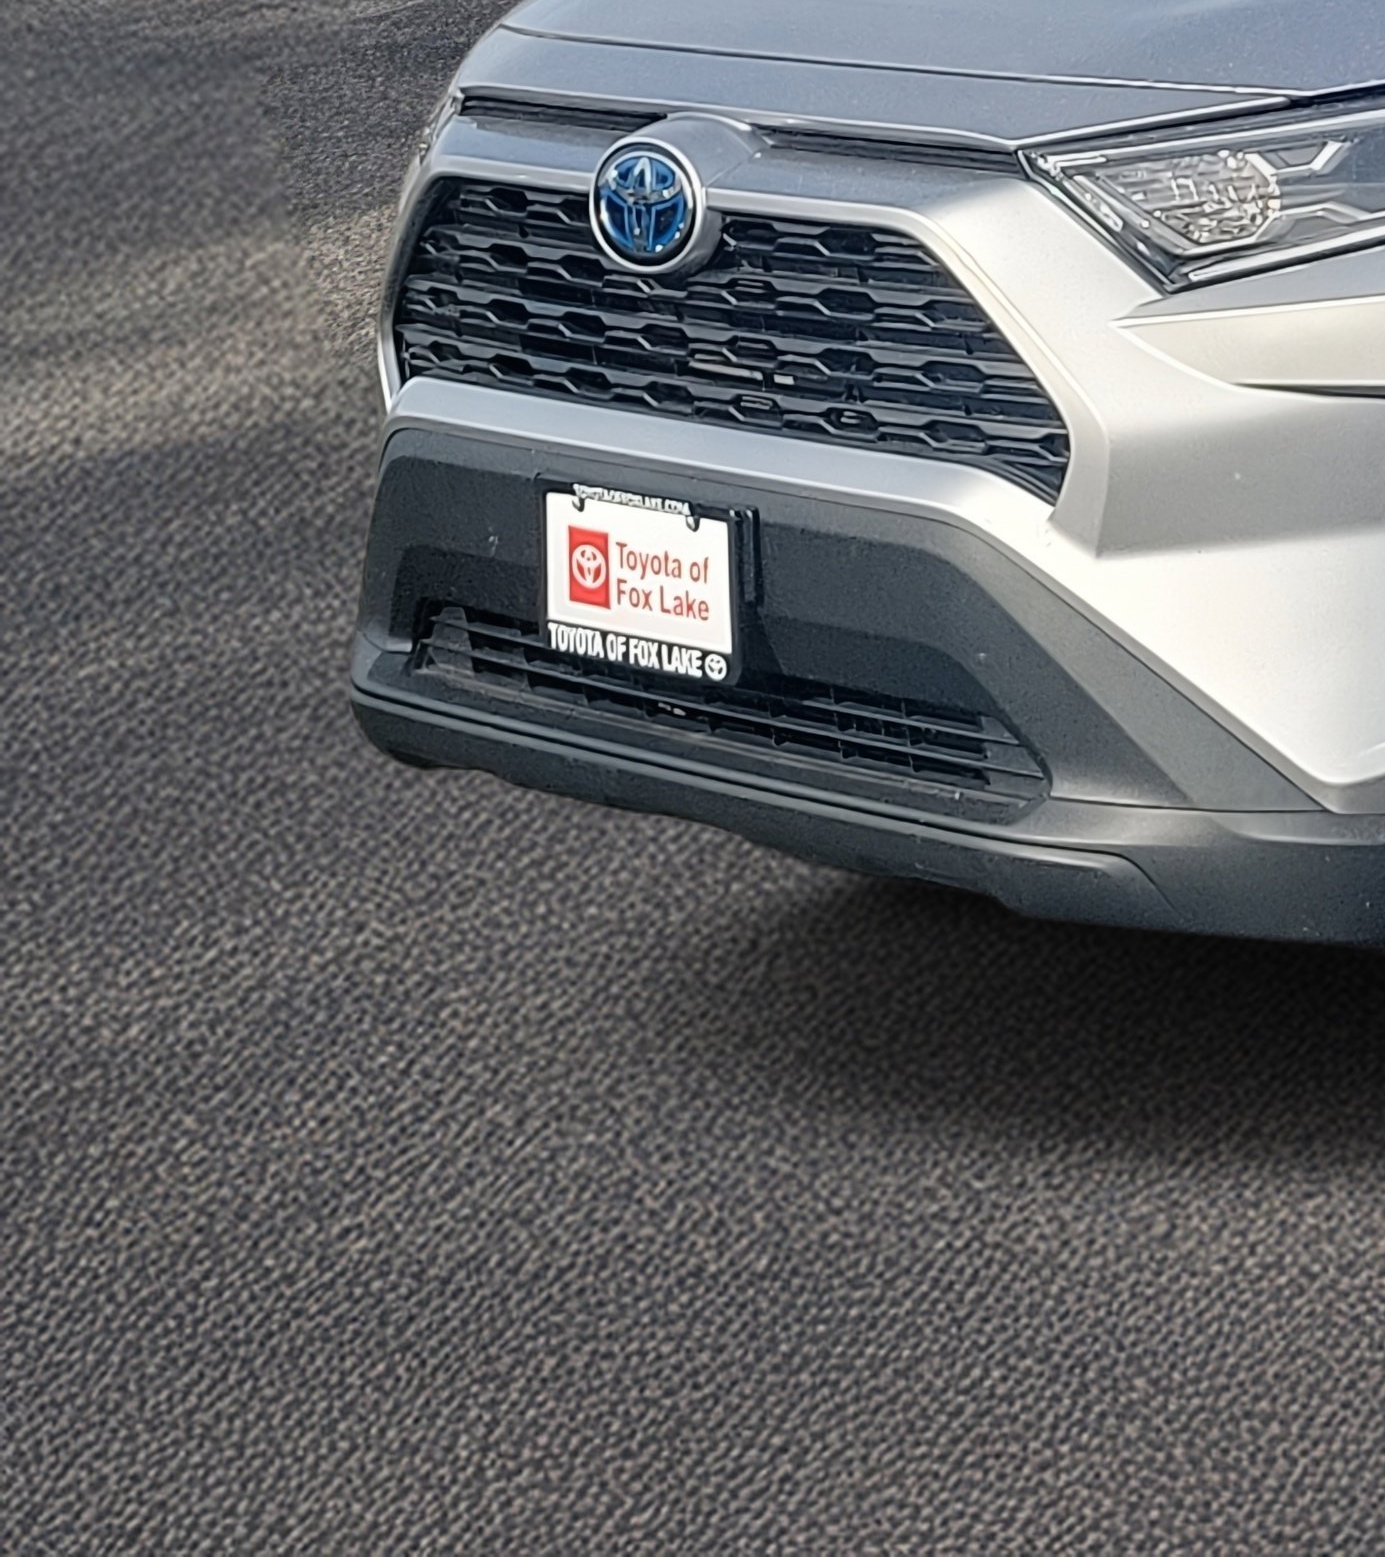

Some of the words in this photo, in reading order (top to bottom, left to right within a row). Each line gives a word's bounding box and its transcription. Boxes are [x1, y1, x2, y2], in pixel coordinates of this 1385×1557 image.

[615, 541, 683, 580] Toyota
[689, 557, 709, 584] of
[616, 578, 654, 611] Fox
[660, 586, 710, 621] Lake
[547, 622, 605, 659] TOYOTA
[607, 634, 627, 662] OF
[629, 639, 661, 669] FOX
[661, 643, 703, 678] LAKE
